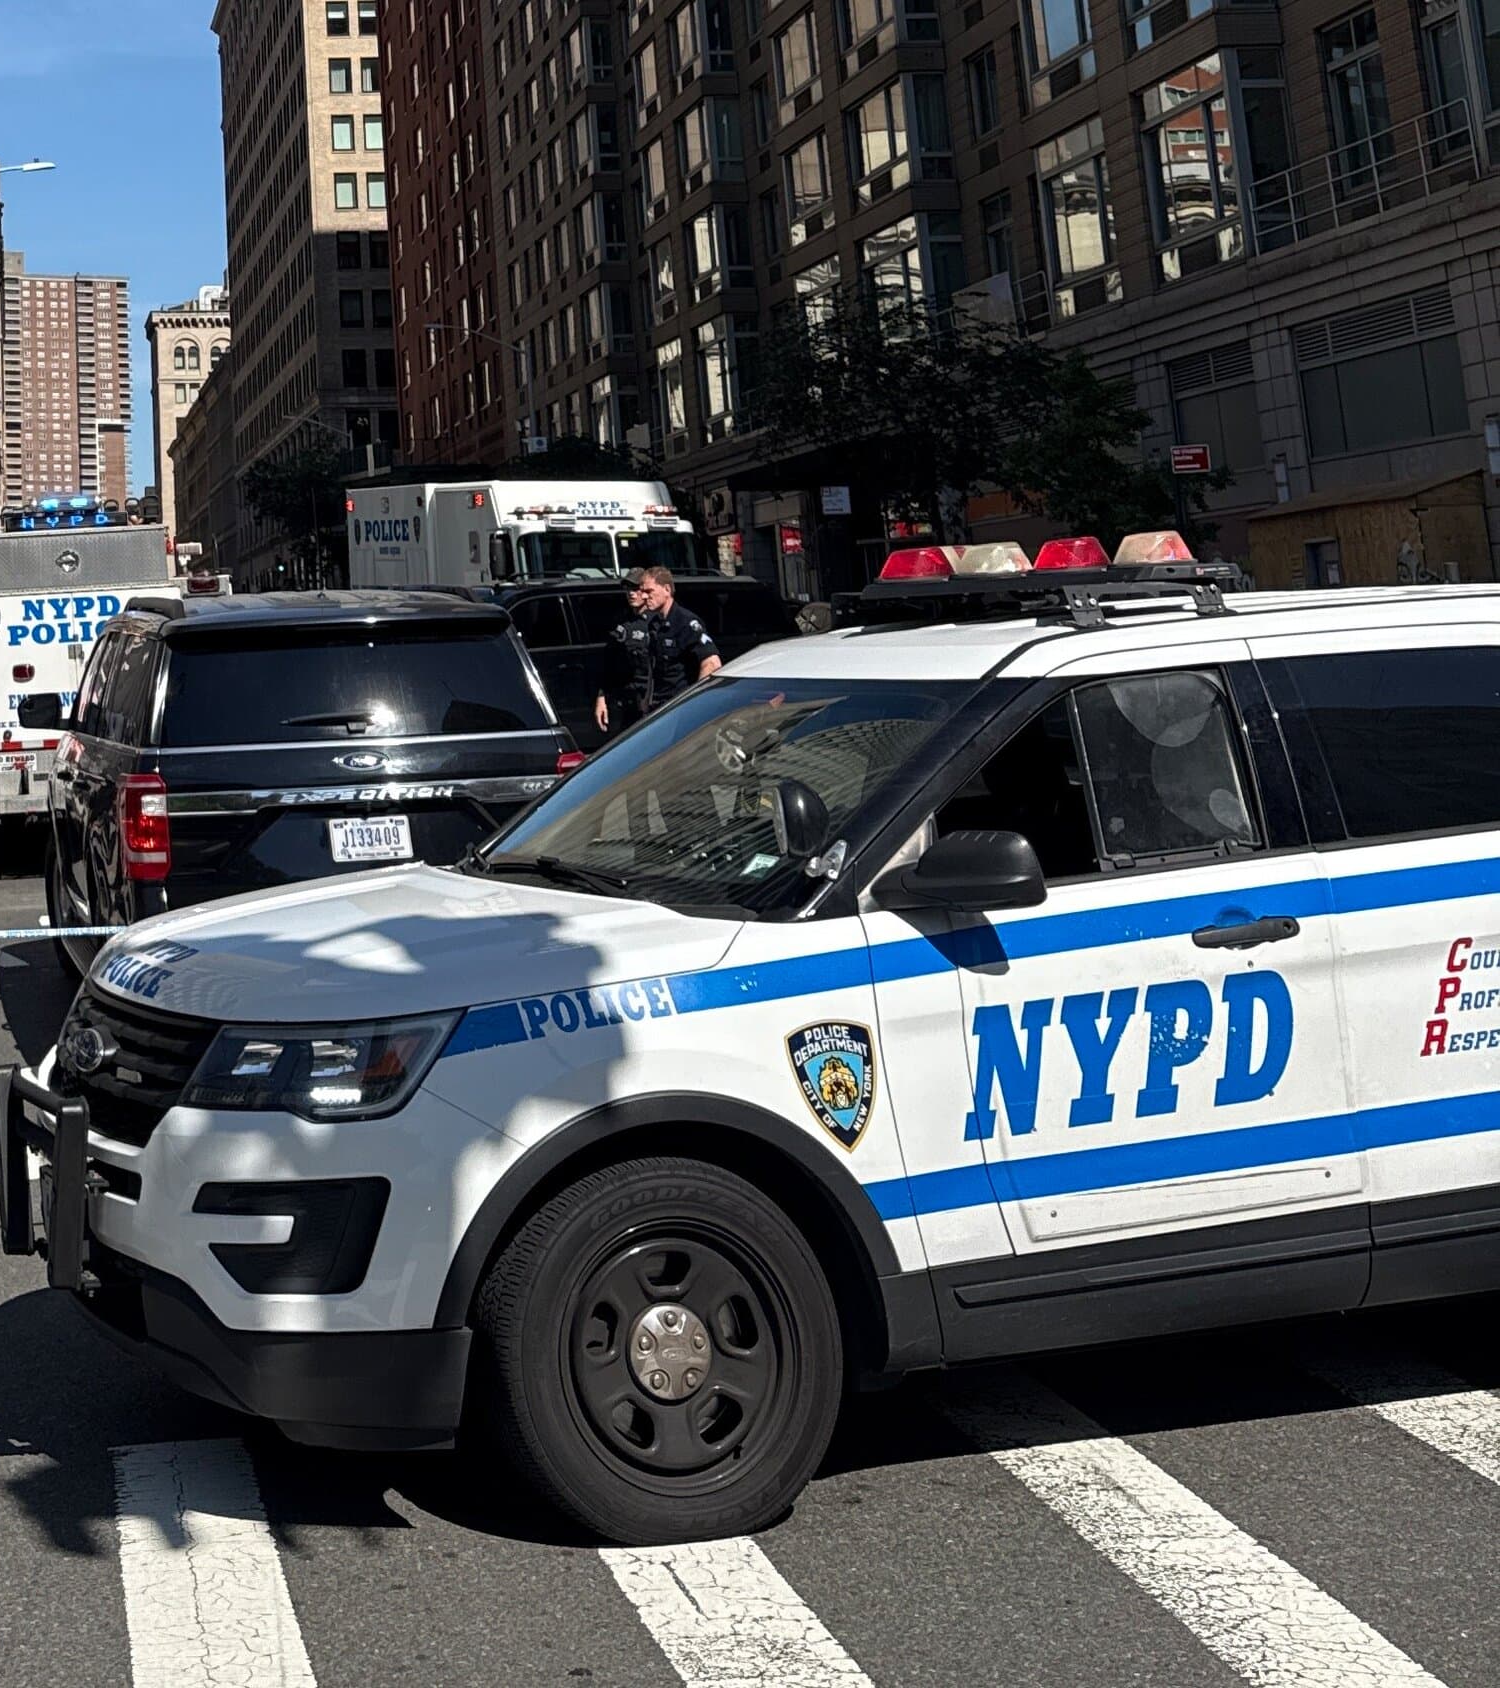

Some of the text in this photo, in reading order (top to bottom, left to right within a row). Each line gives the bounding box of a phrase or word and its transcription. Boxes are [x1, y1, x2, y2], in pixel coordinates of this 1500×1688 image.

[22, 514, 108, 529] NYPD
[572, 508, 628, 516] POLICE
[364, 519, 409, 542] POLICE
[22, 595, 121, 621] NYPD
[7, 620, 106, 646] POLI
[280, 784, 454, 803] EXPEDITION
[342, 826, 401, 848] J133409
[1446, 937, 1500, 973] COU
[100, 951, 175, 998] POLICE
[521, 979, 671, 1040] POLICE
[804, 1025, 850, 1043] POLICE
[793, 1038, 868, 1067] DEPARTMENT
[964, 970, 1293, 1141] NYPD
[802, 1081, 838, 1129] CITY OF
[853, 1064, 872, 1131] NEW YORK
